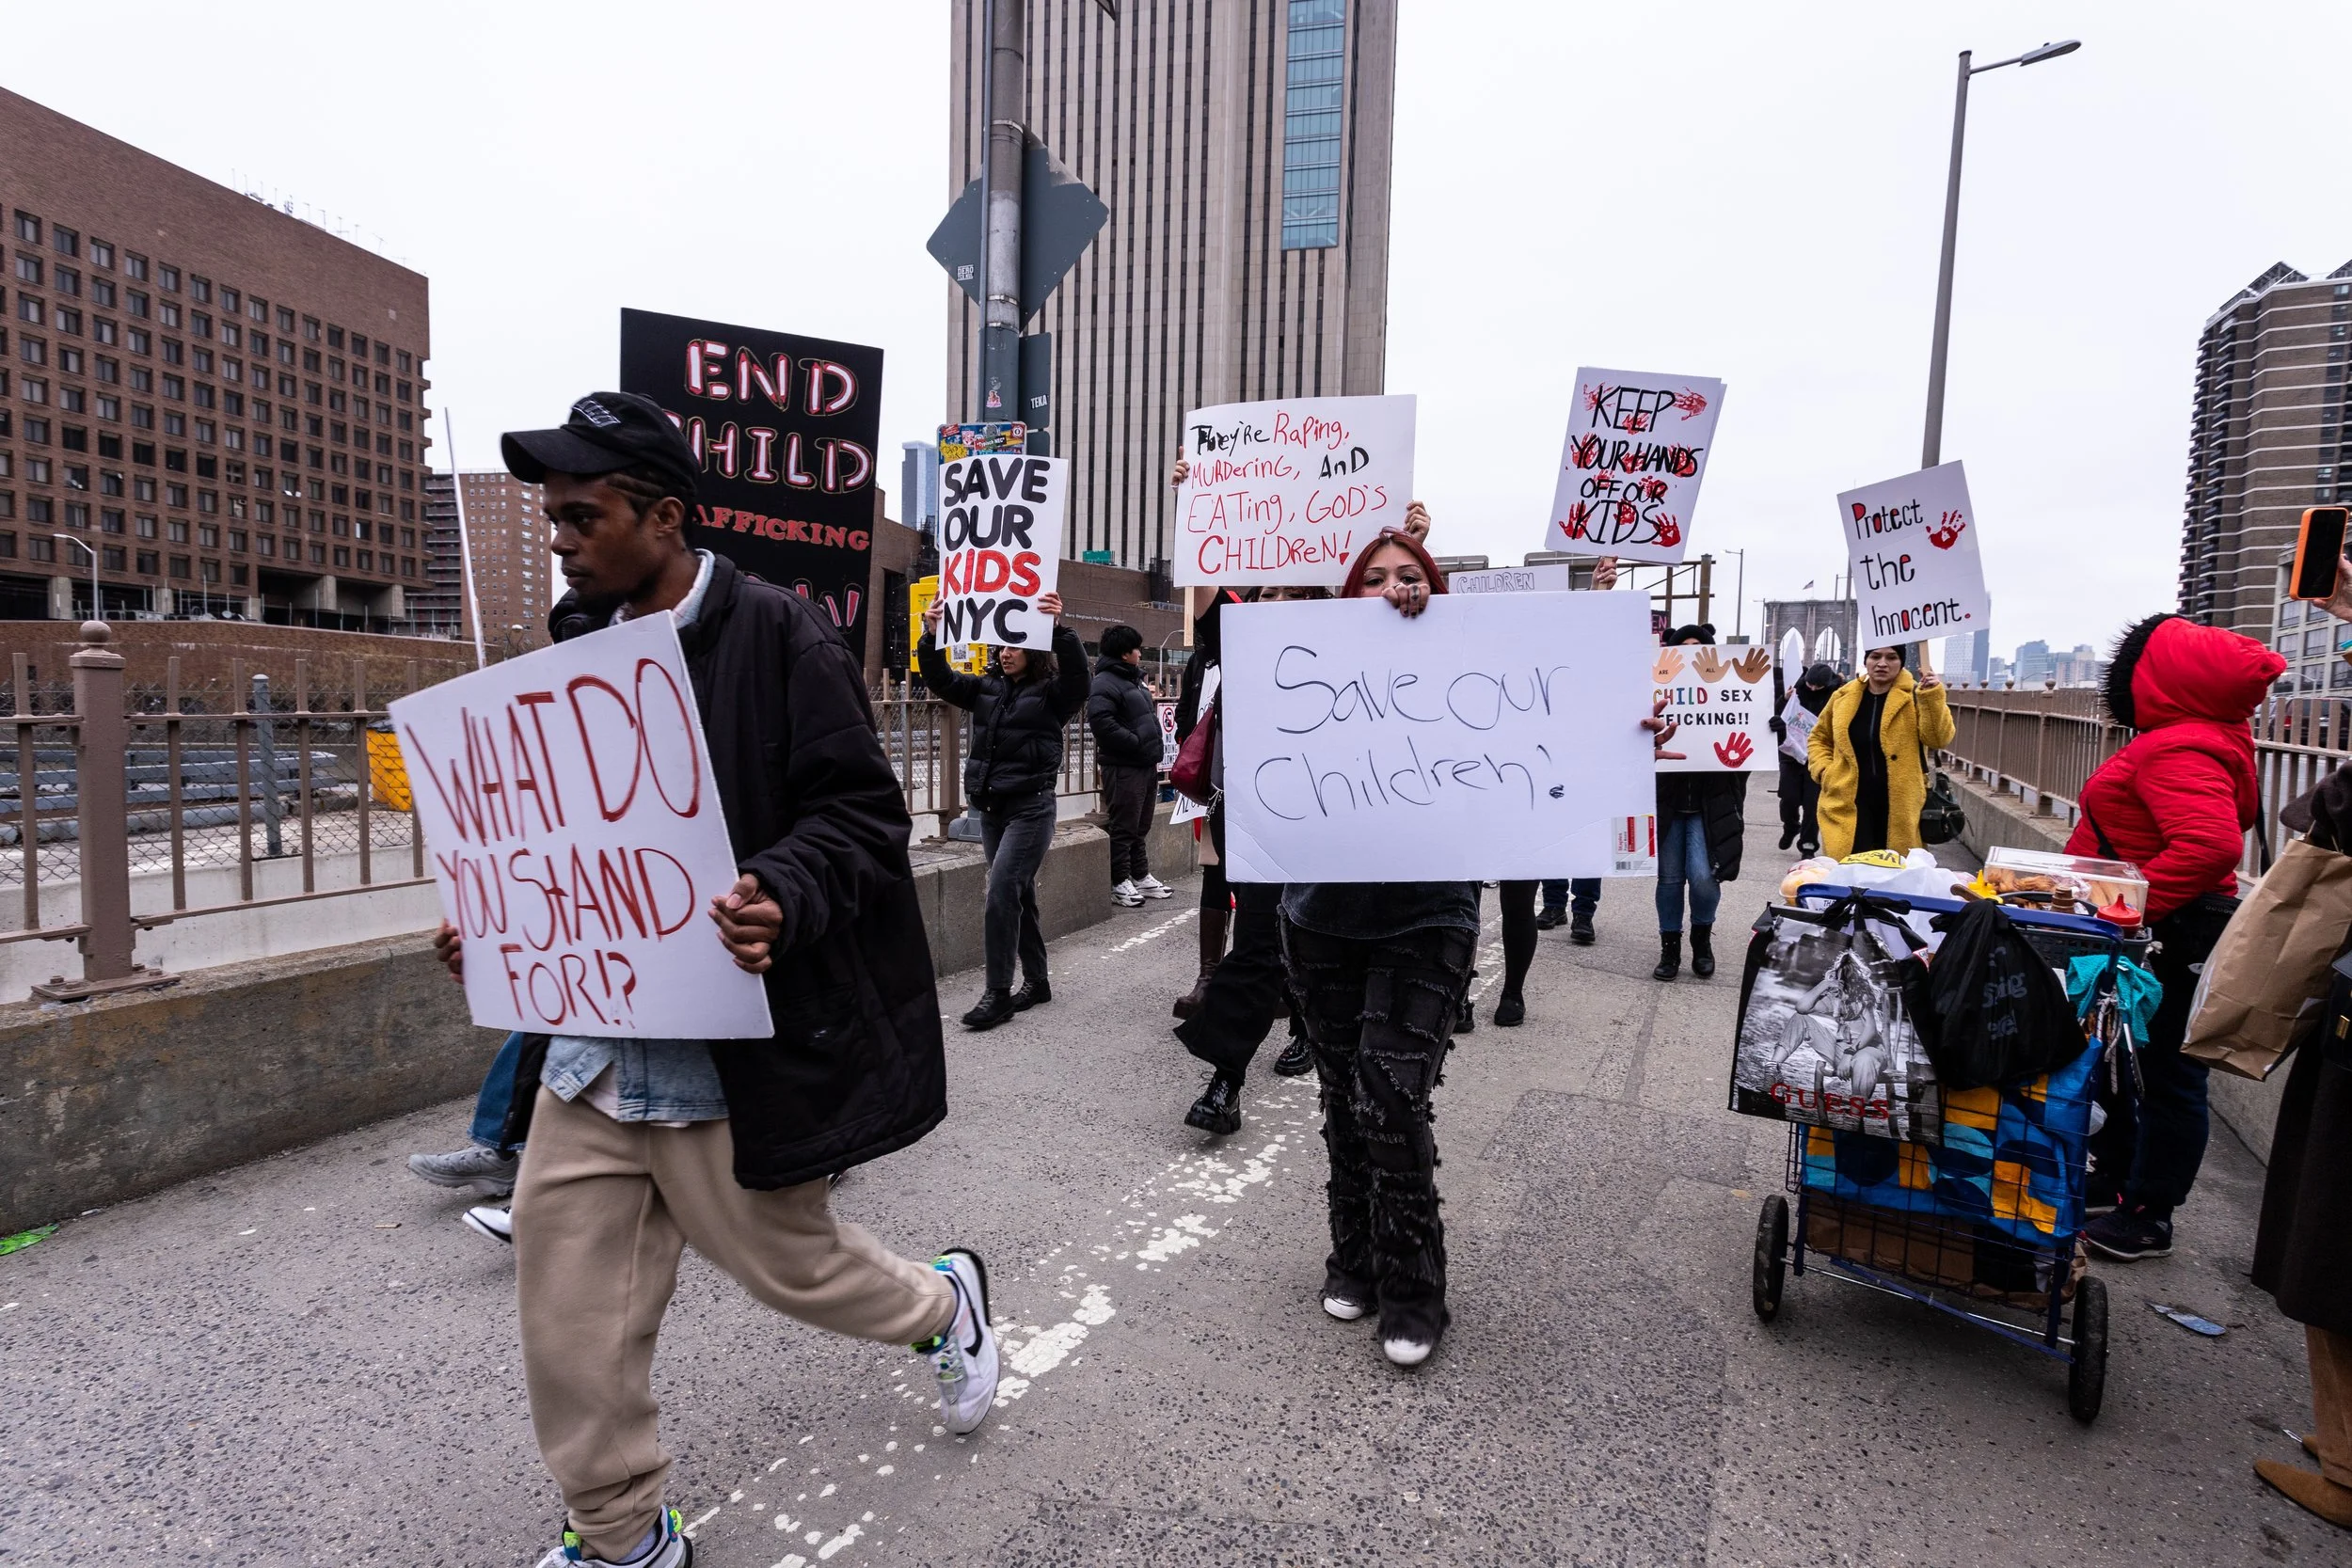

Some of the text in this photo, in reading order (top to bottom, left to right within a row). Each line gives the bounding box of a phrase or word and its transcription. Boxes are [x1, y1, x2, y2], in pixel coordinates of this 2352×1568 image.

[684, 339, 859, 416] END
[1030, 395, 1047, 408] TEKA
[1591, 385, 1677, 433] KEEP
[661, 409, 874, 494] HILD
[1571, 434, 1704, 477] YOUR HANDS
[944, 457, 1051, 507] SAVE
[1581, 478, 1668, 504] OFF OUR
[944, 504, 1034, 551] OUR
[1571, 499, 1661, 545] KIDS
[1851, 499, 1923, 540] Protect
[944, 547, 1041, 599] KIDS
[1456, 572, 1535, 594] CHILDREN
[1860, 553, 1915, 590] the
[944, 597, 1028, 644] NYC
[1871, 598, 1971, 637] Innocent.
[1275, 644, 1444, 734] Save
[1721, 689, 1753, 702] SEX
[405, 658, 699, 847] WHAT DO
[1254, 736, 1565, 820] Children!
[436, 849, 507, 940] YOU
[1770, 1083, 1890, 1119] GUESS
